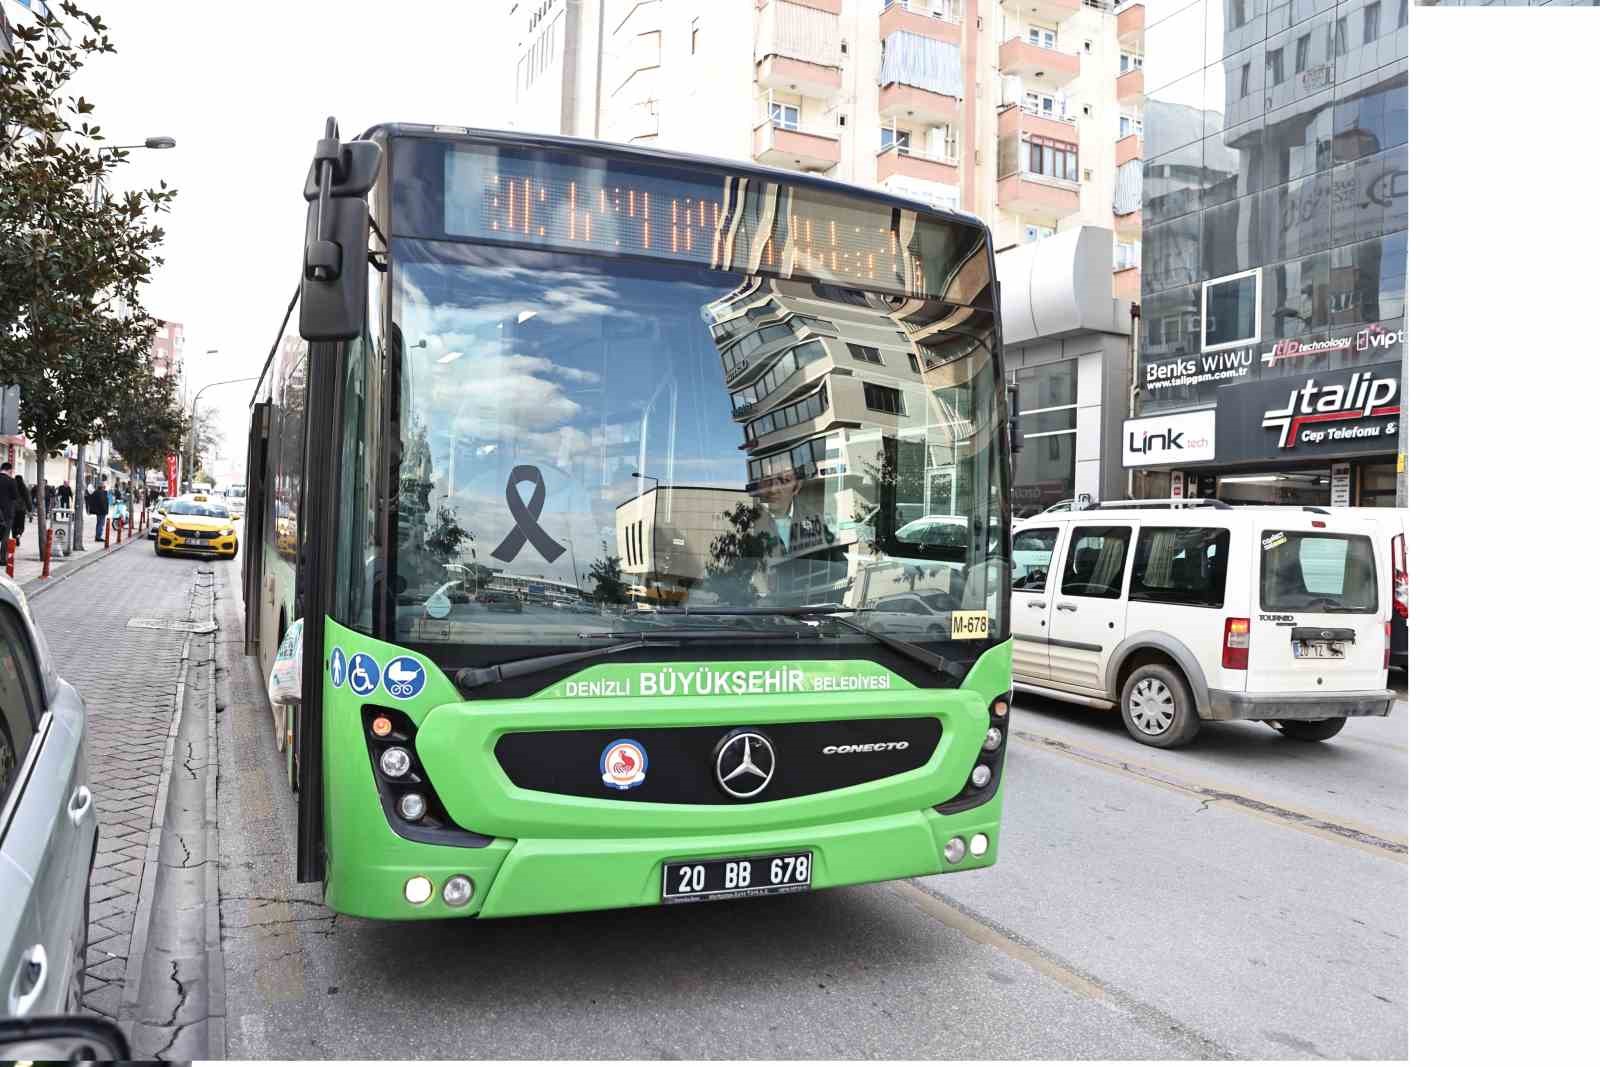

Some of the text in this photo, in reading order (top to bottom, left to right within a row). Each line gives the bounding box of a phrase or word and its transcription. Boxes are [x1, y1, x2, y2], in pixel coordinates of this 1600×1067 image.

[1299, 336, 1352, 352] technology
[1146, 358, 1196, 381] Benks
[1147, 367, 1248, 390] www.talipgsm.com.tr
[1299, 371, 1397, 417] talip
[1129, 427, 1209, 455] Link tech
[1301, 421, 1399, 443] Cep Telefonu &
[953, 615, 987, 633] M-678
[565, 665, 891, 697] DENİZLİ BÜYÜKŞEHİR BELEDİYESİ
[822, 741, 910, 755] CONECTO
[678, 856, 808, 893] 20 BB 678
